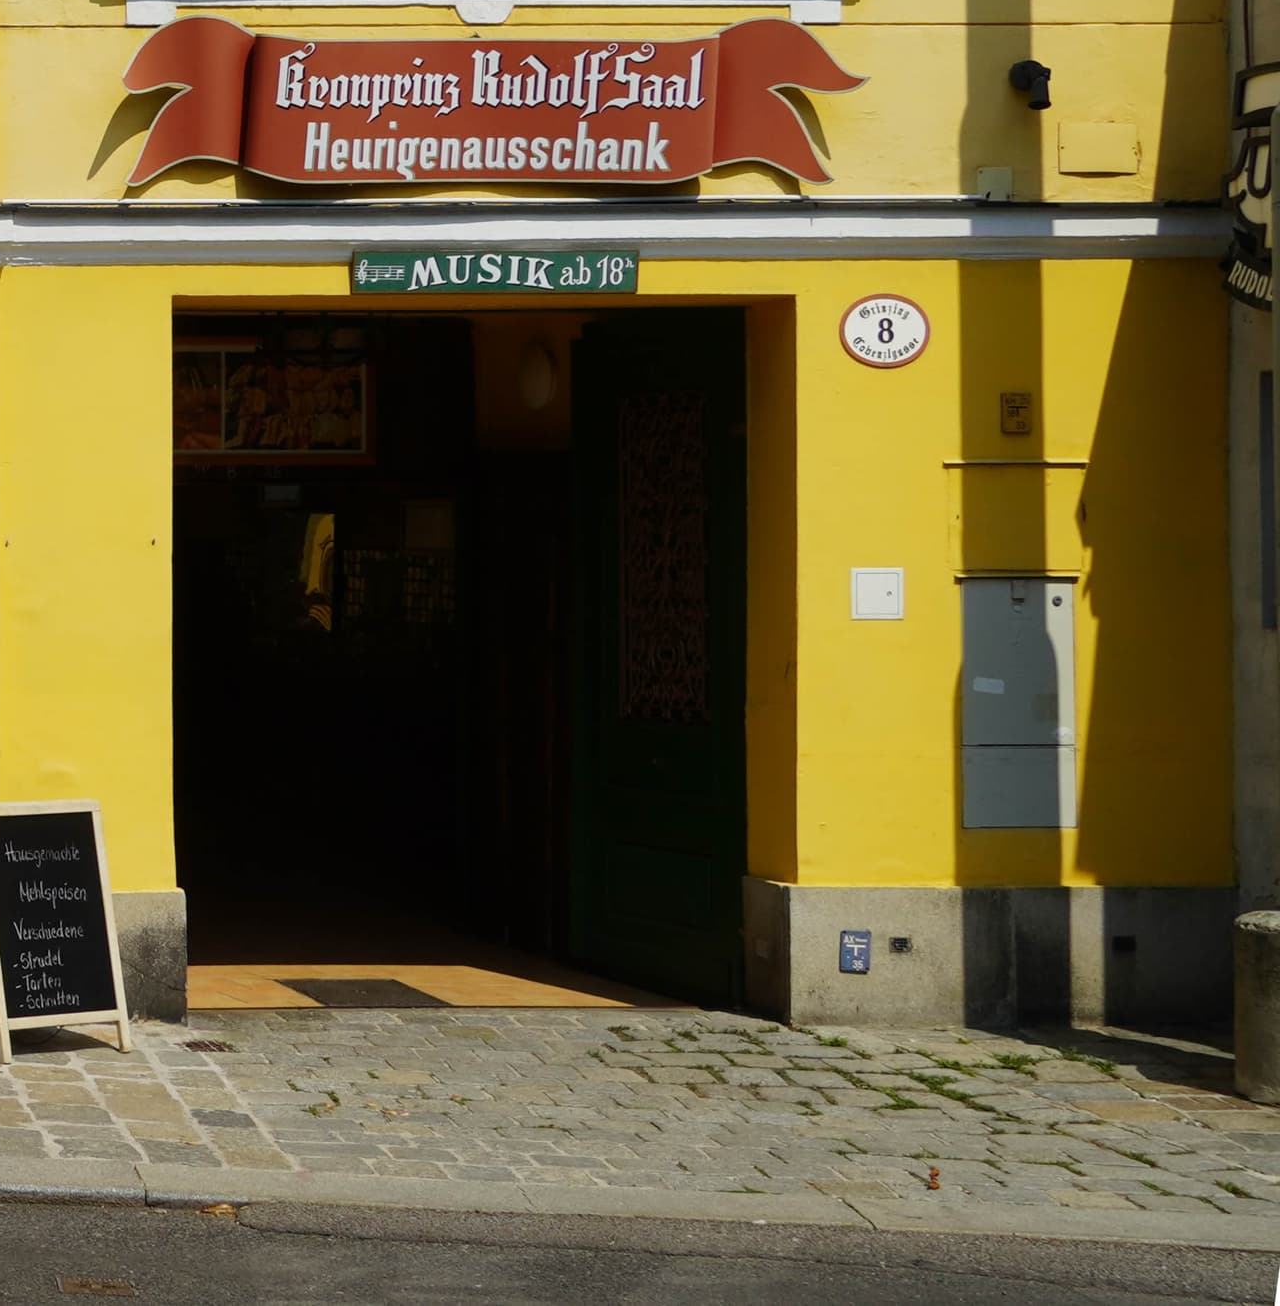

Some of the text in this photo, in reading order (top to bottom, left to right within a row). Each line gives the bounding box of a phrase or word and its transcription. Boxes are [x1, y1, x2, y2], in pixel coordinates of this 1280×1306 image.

[274, 43, 706, 121] Kronprinz Rudolf Saal
[303, 121, 672, 180] Heurigenausschank
[407, 254, 555, 291] MUSIK
[559, 255, 591, 287] ab
[858, 302, 911, 320] Grinzing
[877, 317, 895, 344] 8
[19, 880, 87, 910] Mehlspeisen
[13, 918, 84, 941] Verschiedene
